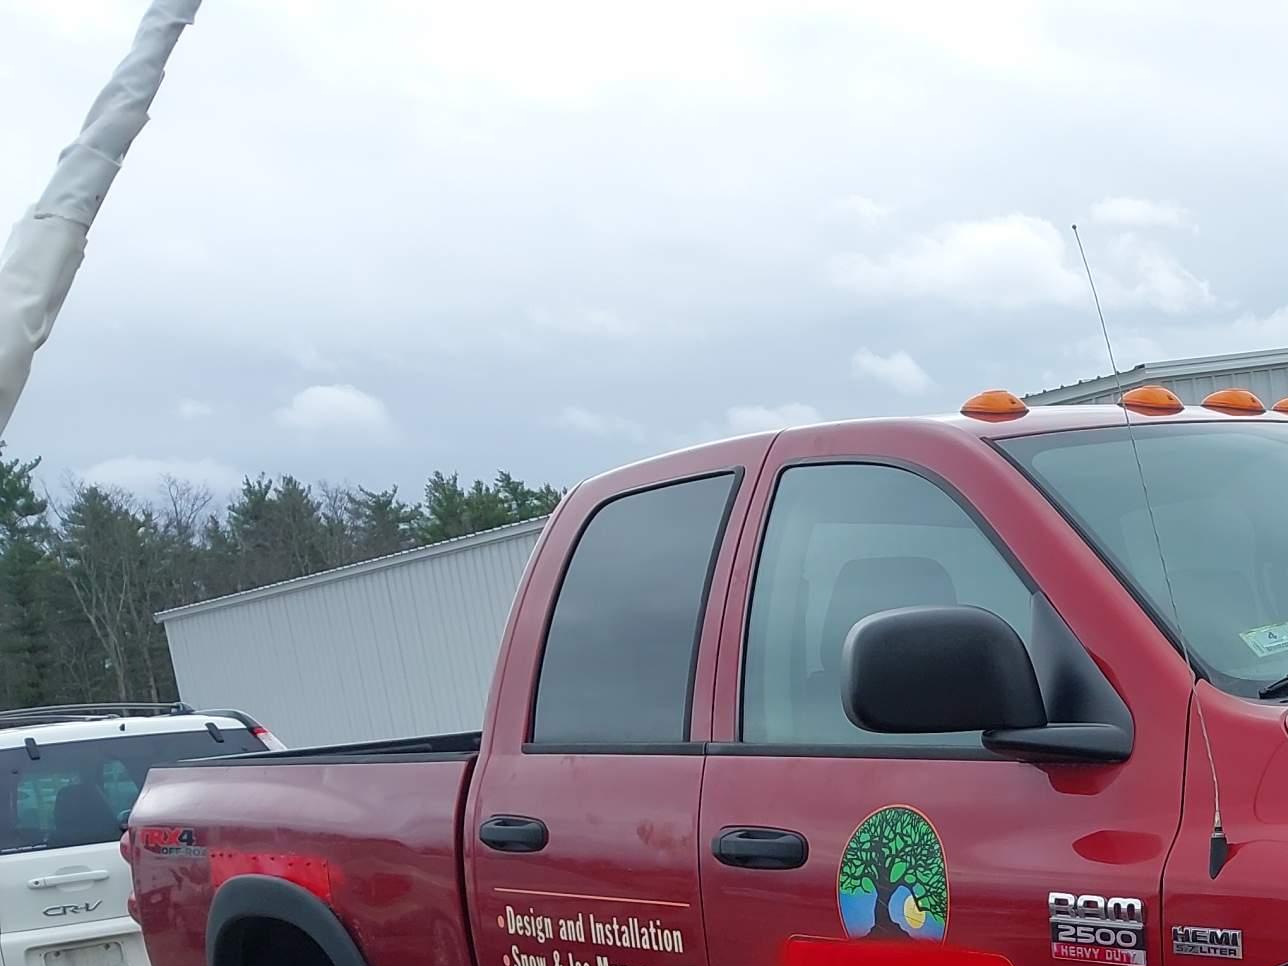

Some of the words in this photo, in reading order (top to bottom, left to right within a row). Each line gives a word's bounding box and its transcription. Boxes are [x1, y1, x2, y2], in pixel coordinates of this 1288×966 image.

[141, 826, 196, 847] TRX4
[42, 899, 103, 918] CR-V
[1048, 891, 1144, 923] RAM
[505, 905, 553, 944] Design
[559, 913, 585, 943] and
[590, 914, 684, 953] Installation
[1058, 924, 1137, 947] 2500
[1172, 926, 1240, 947] HEMI
[1061, 944, 1100, 960] HEAVY
[1105, 949, 1137, 964] DUTY
[1199, 946, 1237, 957] LITER
